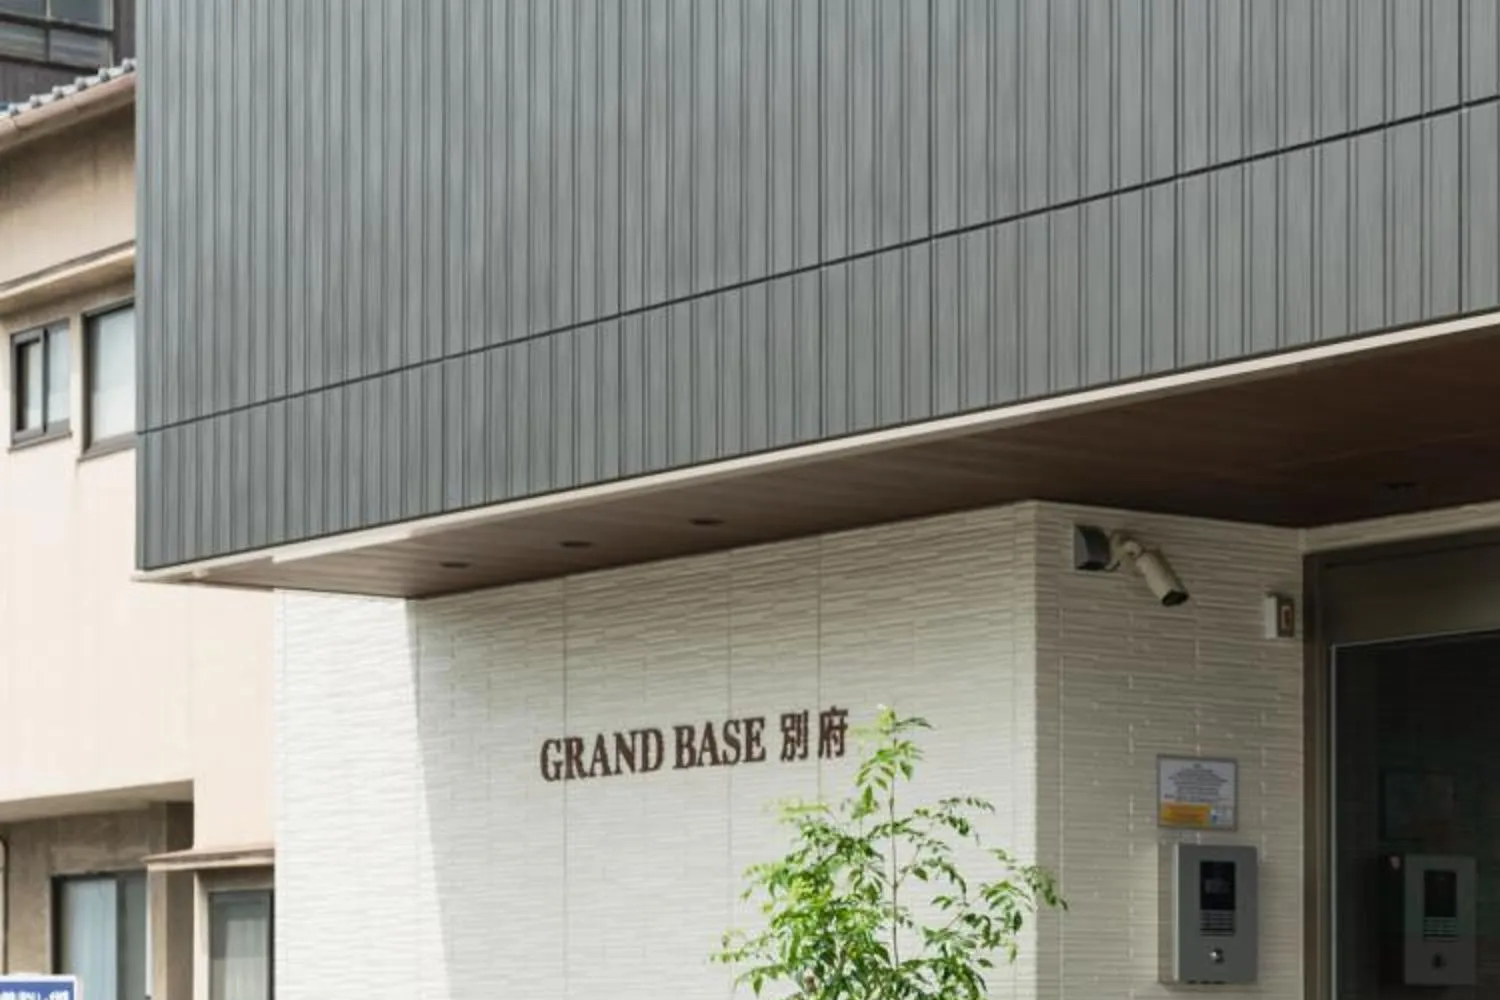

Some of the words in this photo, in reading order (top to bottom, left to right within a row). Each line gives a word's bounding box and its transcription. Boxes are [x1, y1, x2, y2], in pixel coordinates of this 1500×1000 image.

[540, 727, 664, 782] GRAND
[672, 716, 766, 769] BASE
[779, 705, 849, 763] 別府
